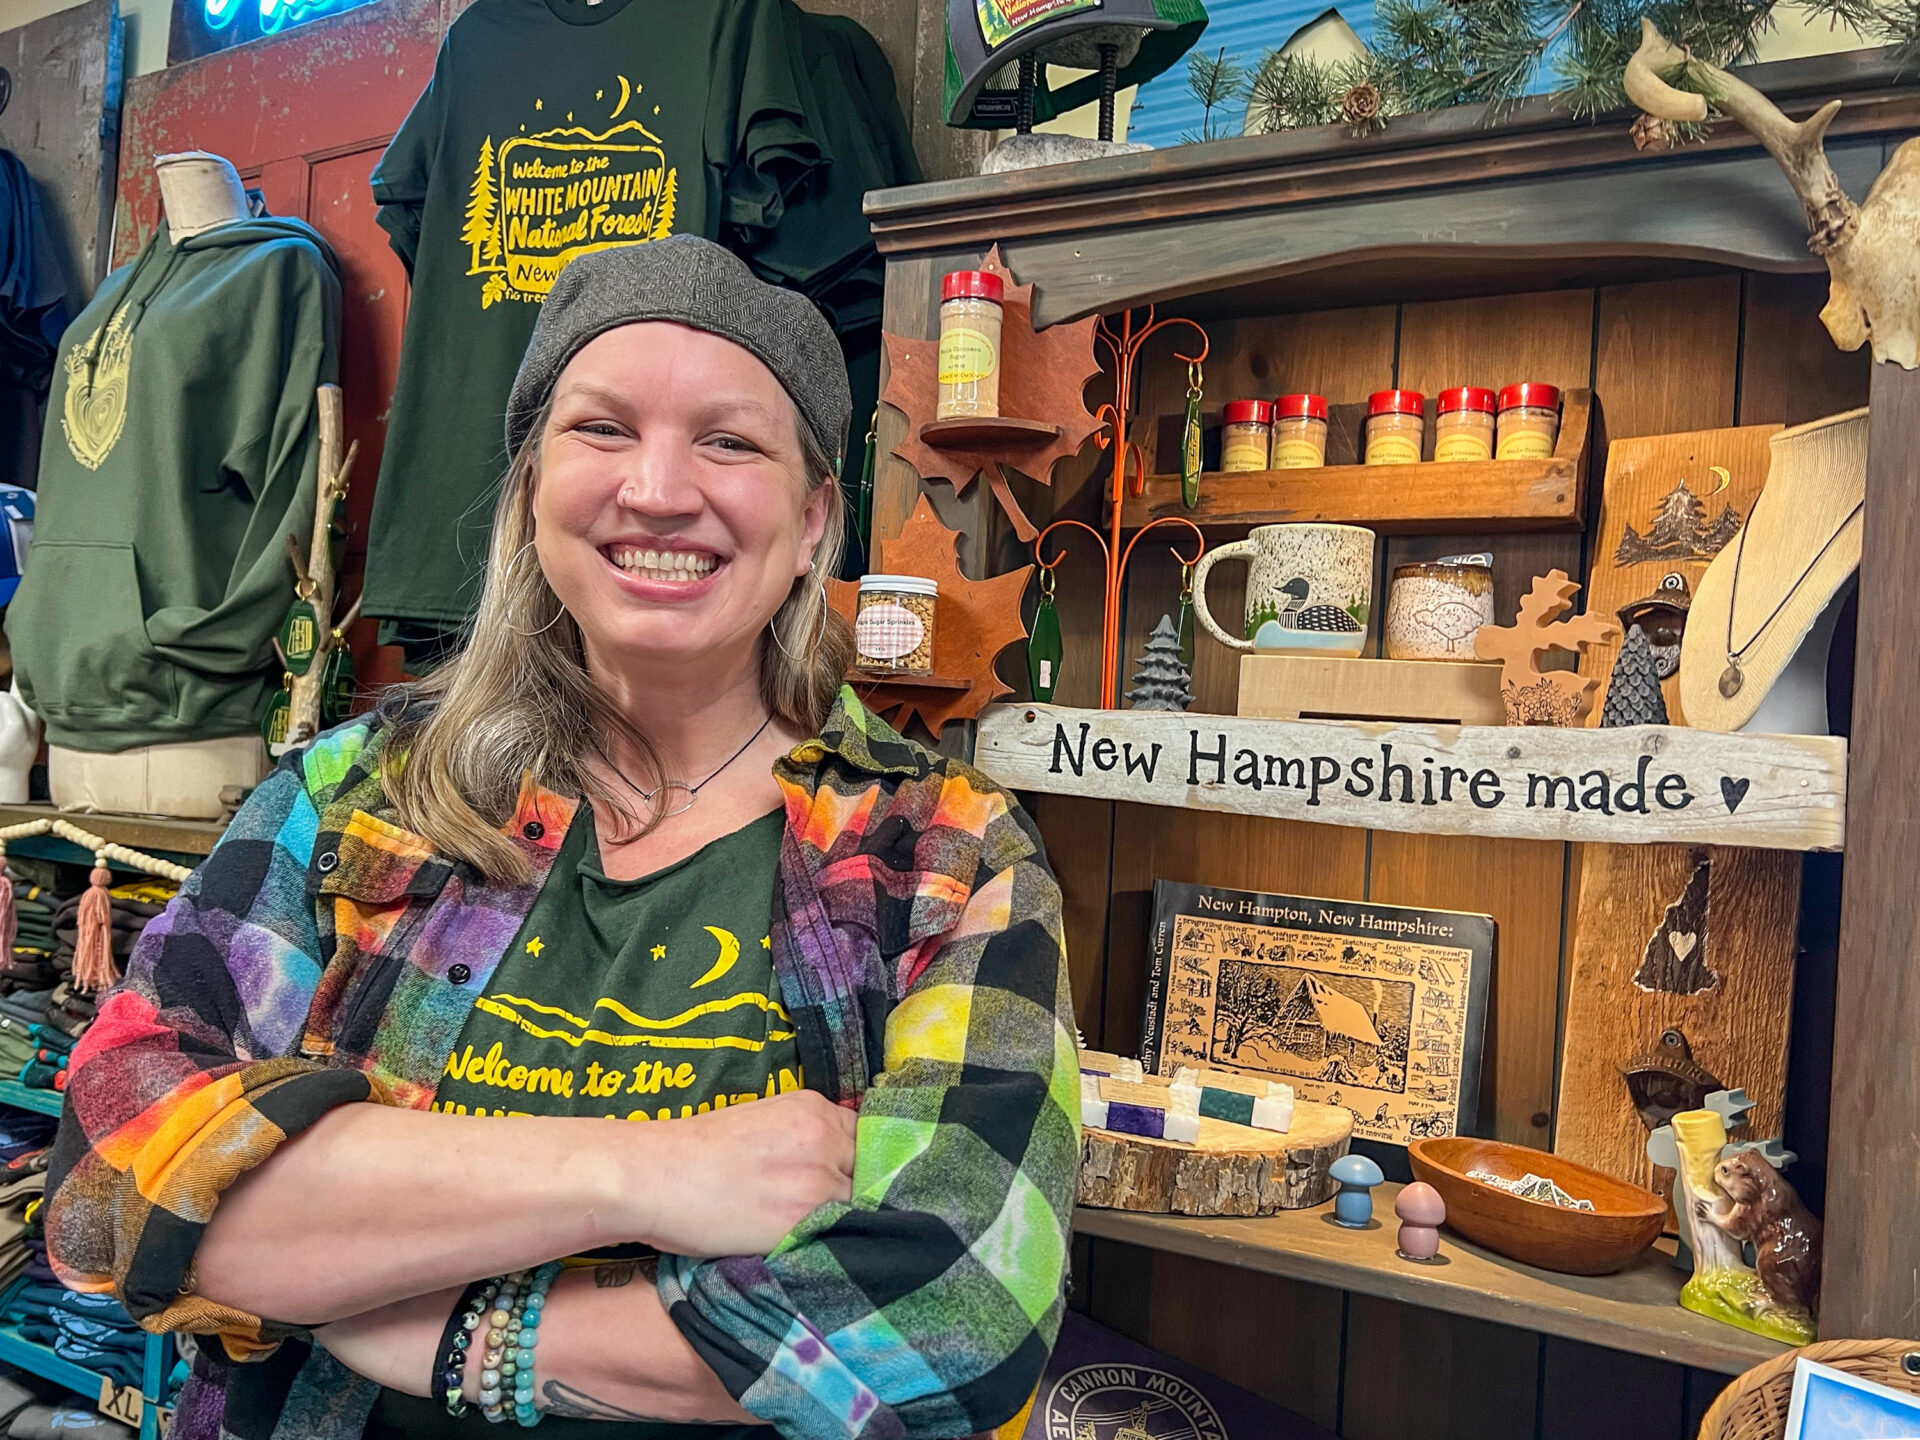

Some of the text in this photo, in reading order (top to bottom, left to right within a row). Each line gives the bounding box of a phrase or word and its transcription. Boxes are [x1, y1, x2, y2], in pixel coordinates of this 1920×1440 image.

[1012, 12, 1028, 26] New
[512, 156, 610, 179] Welcome to the
[505, 167, 662, 216] WHITE MOUNTAIN
[508, 201, 652, 250] National Forest
[516, 263, 558, 282] New
[886, 618, 915, 626] Sprinkles
[1048, 722, 1695, 816] New Hampshire made
[1197, 895, 1454, 938] New Hampton, New Hampshire:
[1154, 921, 1167, 955] Curren
[1151, 957, 1162, 978] Tom
[1150, 980, 1160, 999] and
[1144, 1001, 1158, 1045] Neustadt
[443, 1042, 573, 1098] Welcome
[579, 1061, 626, 1097] to
[625, 1060, 697, 1094] the
[105, 1385, 140, 1423] XL
[1060, 1369, 1223, 1440] CANNON MOUNTA
